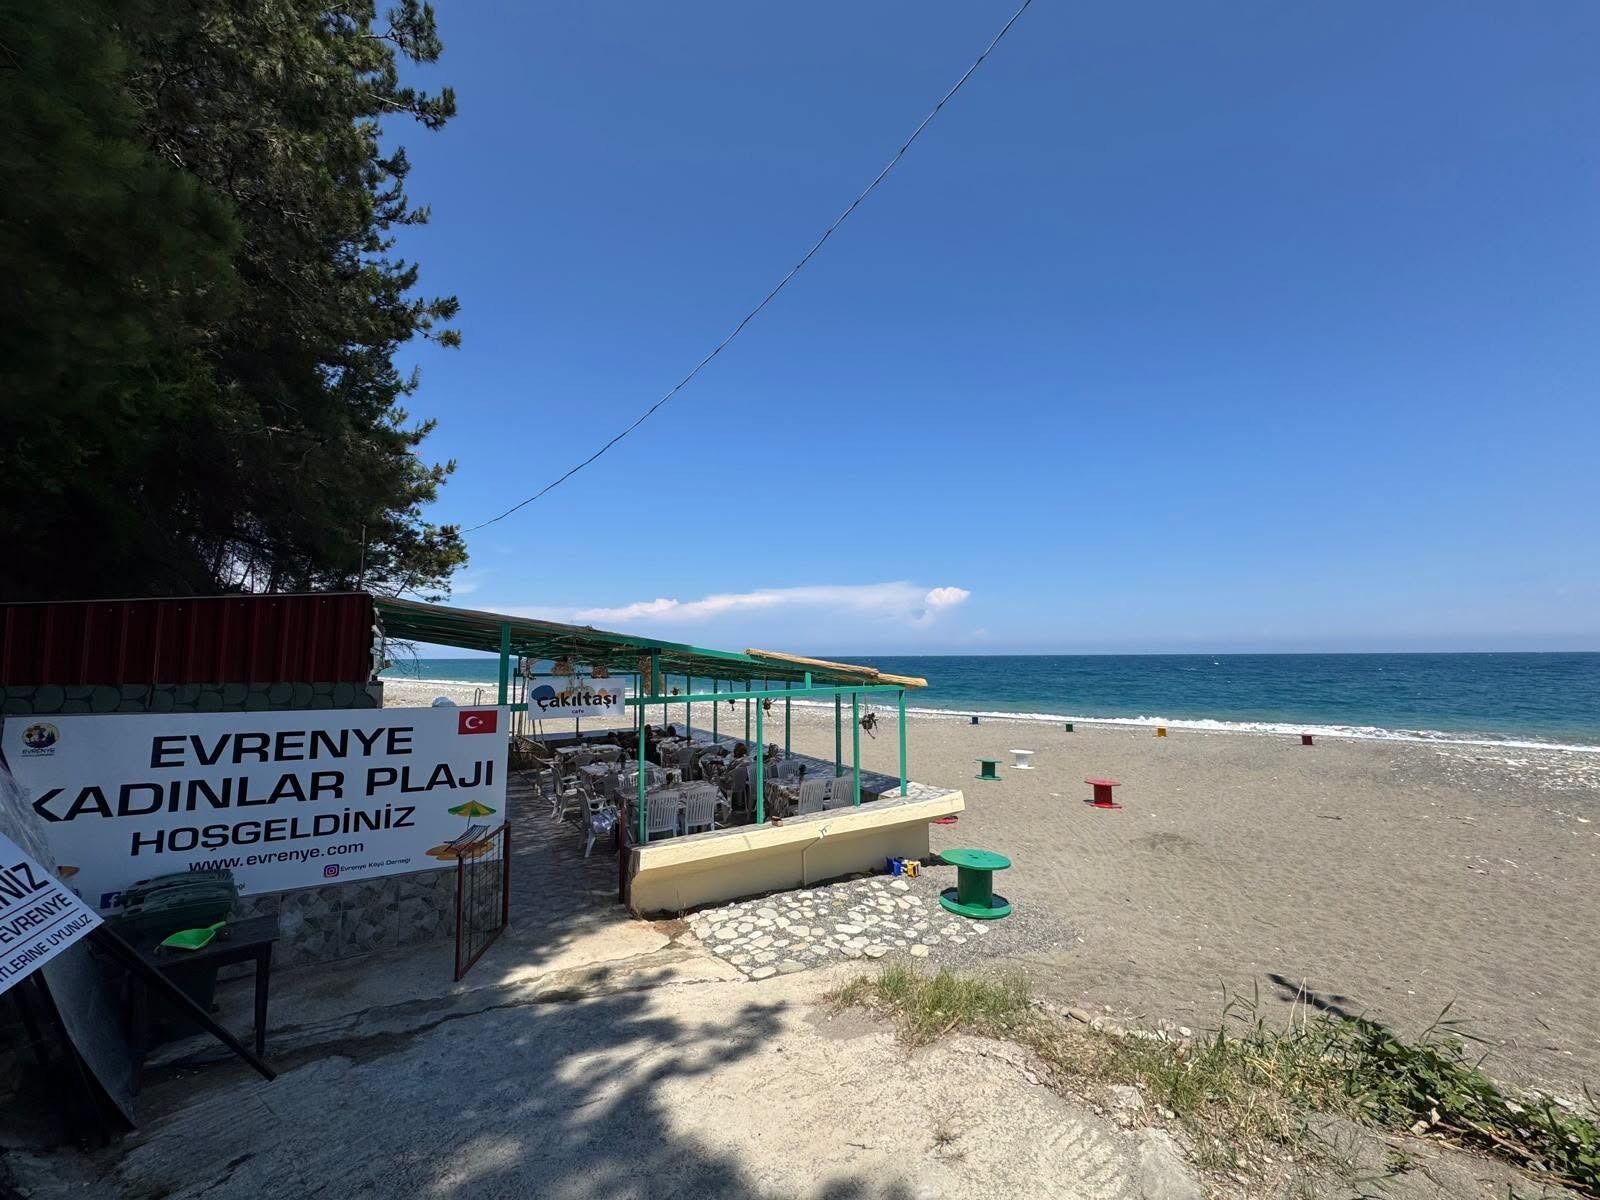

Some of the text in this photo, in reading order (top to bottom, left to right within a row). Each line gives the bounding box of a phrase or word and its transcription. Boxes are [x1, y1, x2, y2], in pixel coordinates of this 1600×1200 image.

[150, 727, 414, 768] EVRENYE
[366, 760, 494, 796] PLAJI
[131, 803, 416, 856] HOŞGELDİNİZ
[189, 842, 364, 872] www.evrenye.com
[341, 864, 367, 872] Evrenye
[0, 862, 50, 910] NİZ
[0, 893, 73, 944] EVRENYE
[0, 913, 93, 982] TLERİNE UYUNUZ
